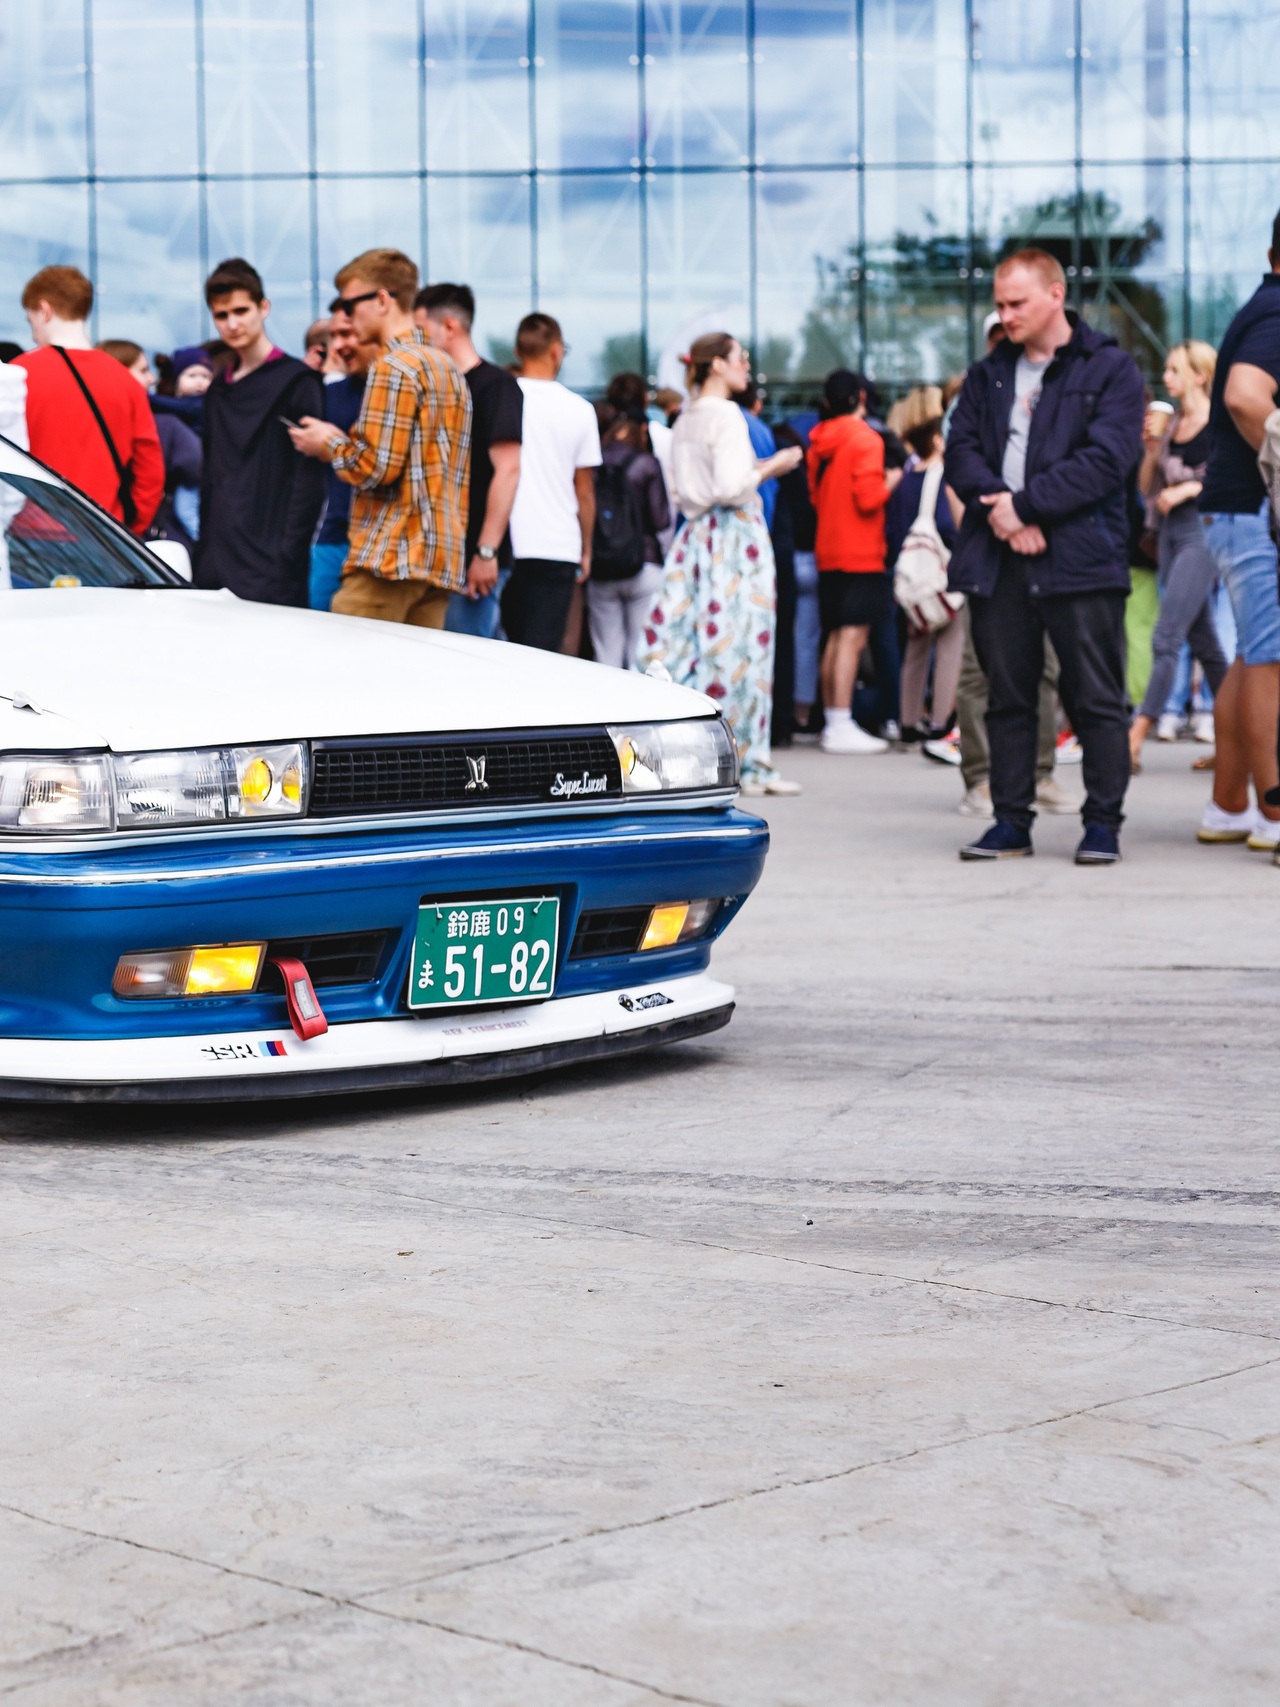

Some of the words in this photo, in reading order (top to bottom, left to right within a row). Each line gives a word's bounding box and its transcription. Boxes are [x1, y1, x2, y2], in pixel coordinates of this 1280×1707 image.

[447, 910, 491, 938] 鈴鹿
[497, 907, 524, 936] 09
[418, 959, 435, 989] ま
[443, 939, 550, 998] 51-82
